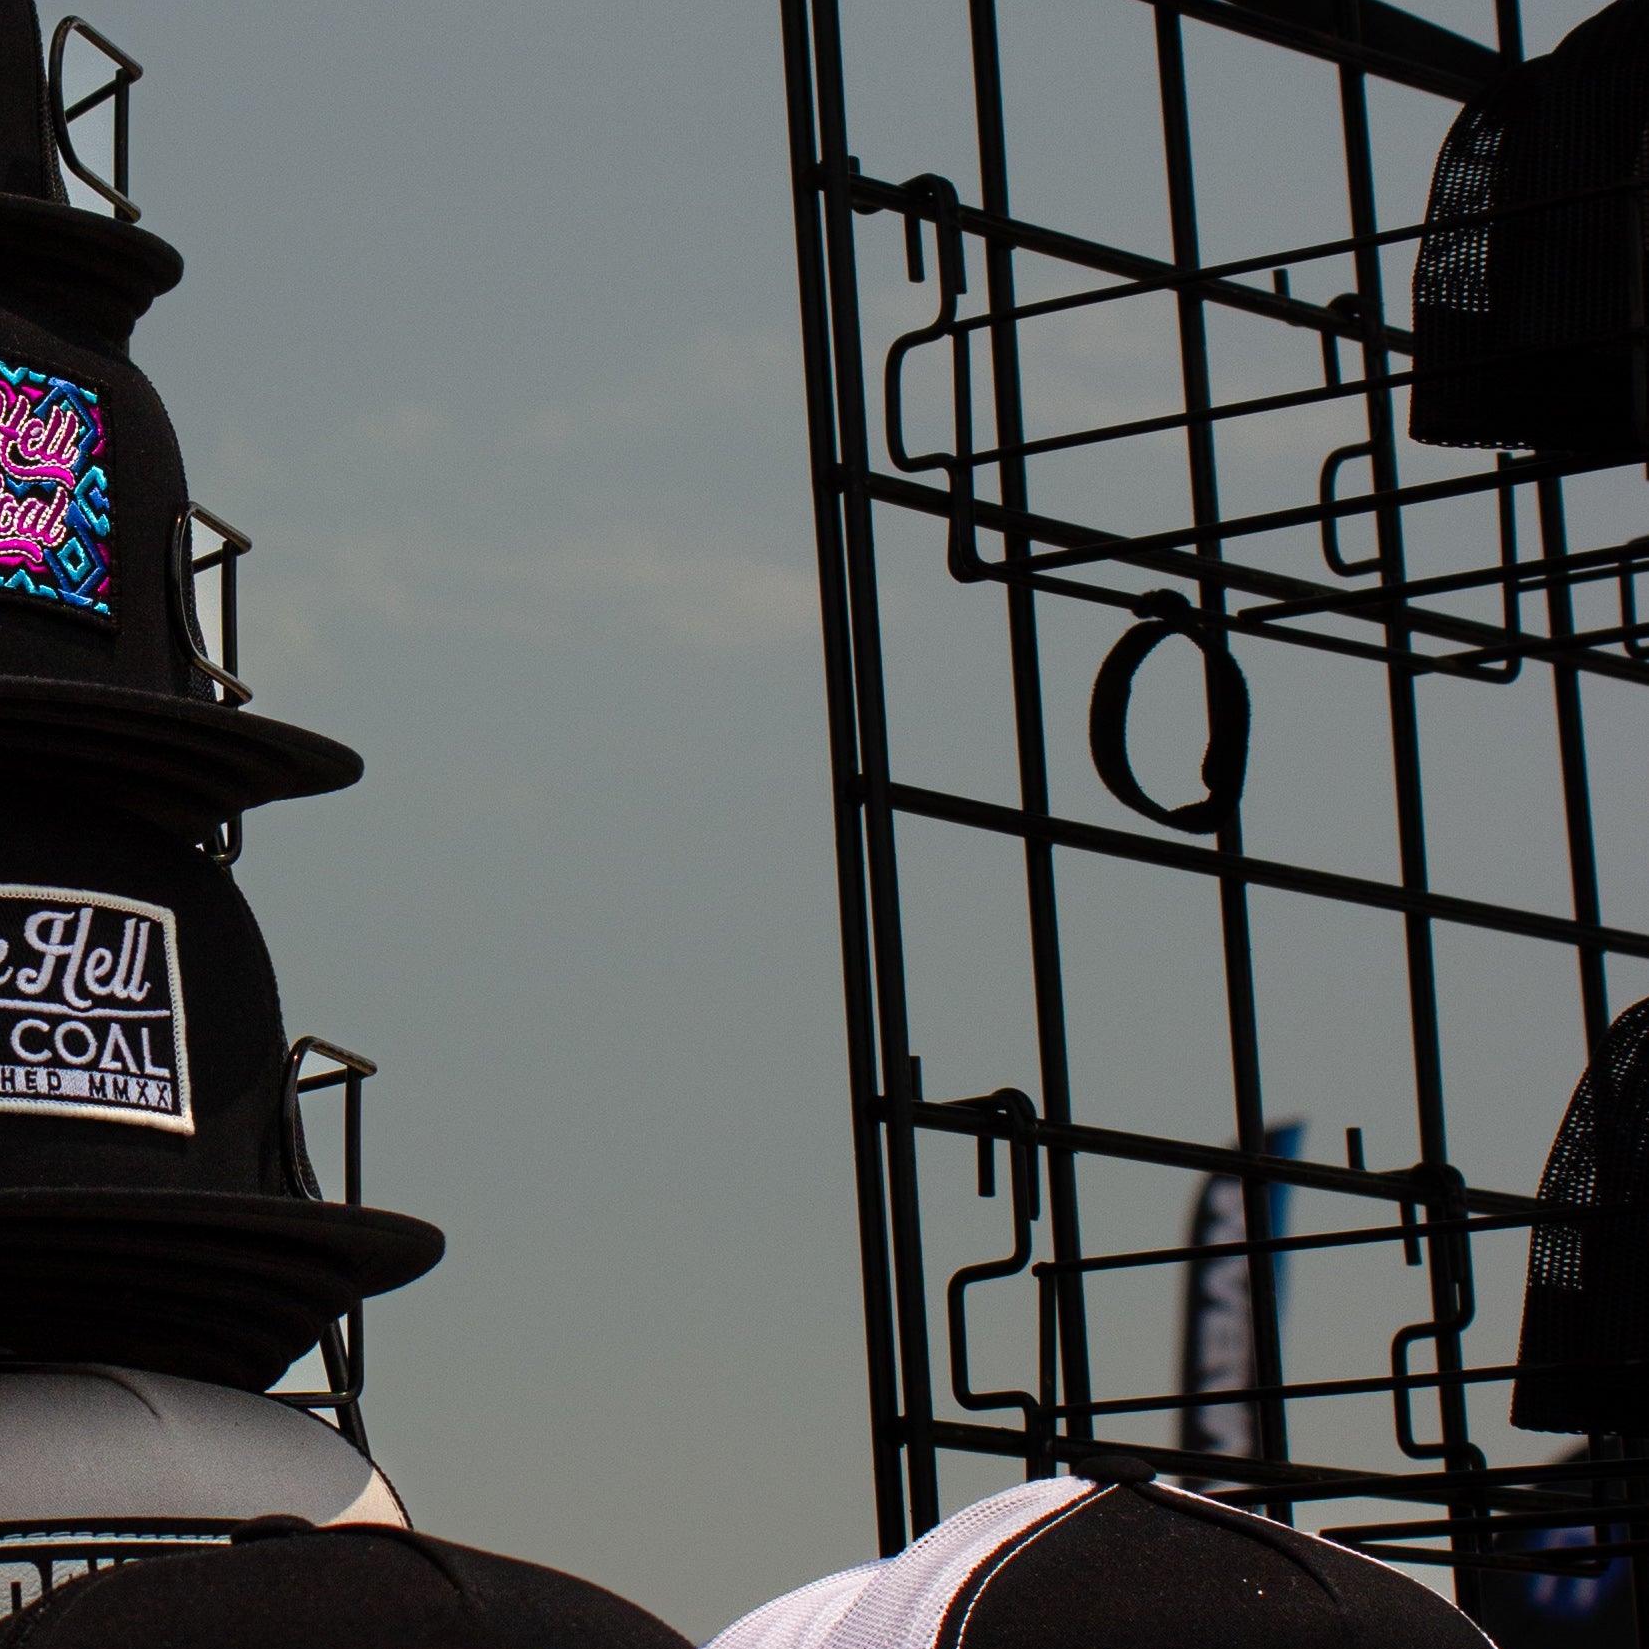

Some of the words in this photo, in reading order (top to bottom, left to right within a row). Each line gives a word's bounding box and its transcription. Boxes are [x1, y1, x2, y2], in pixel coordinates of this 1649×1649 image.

[15, 906, 152, 1010] Hell
[9, 1017, 171, 1078] COAL
[87, 1076, 170, 1108] MMXX
